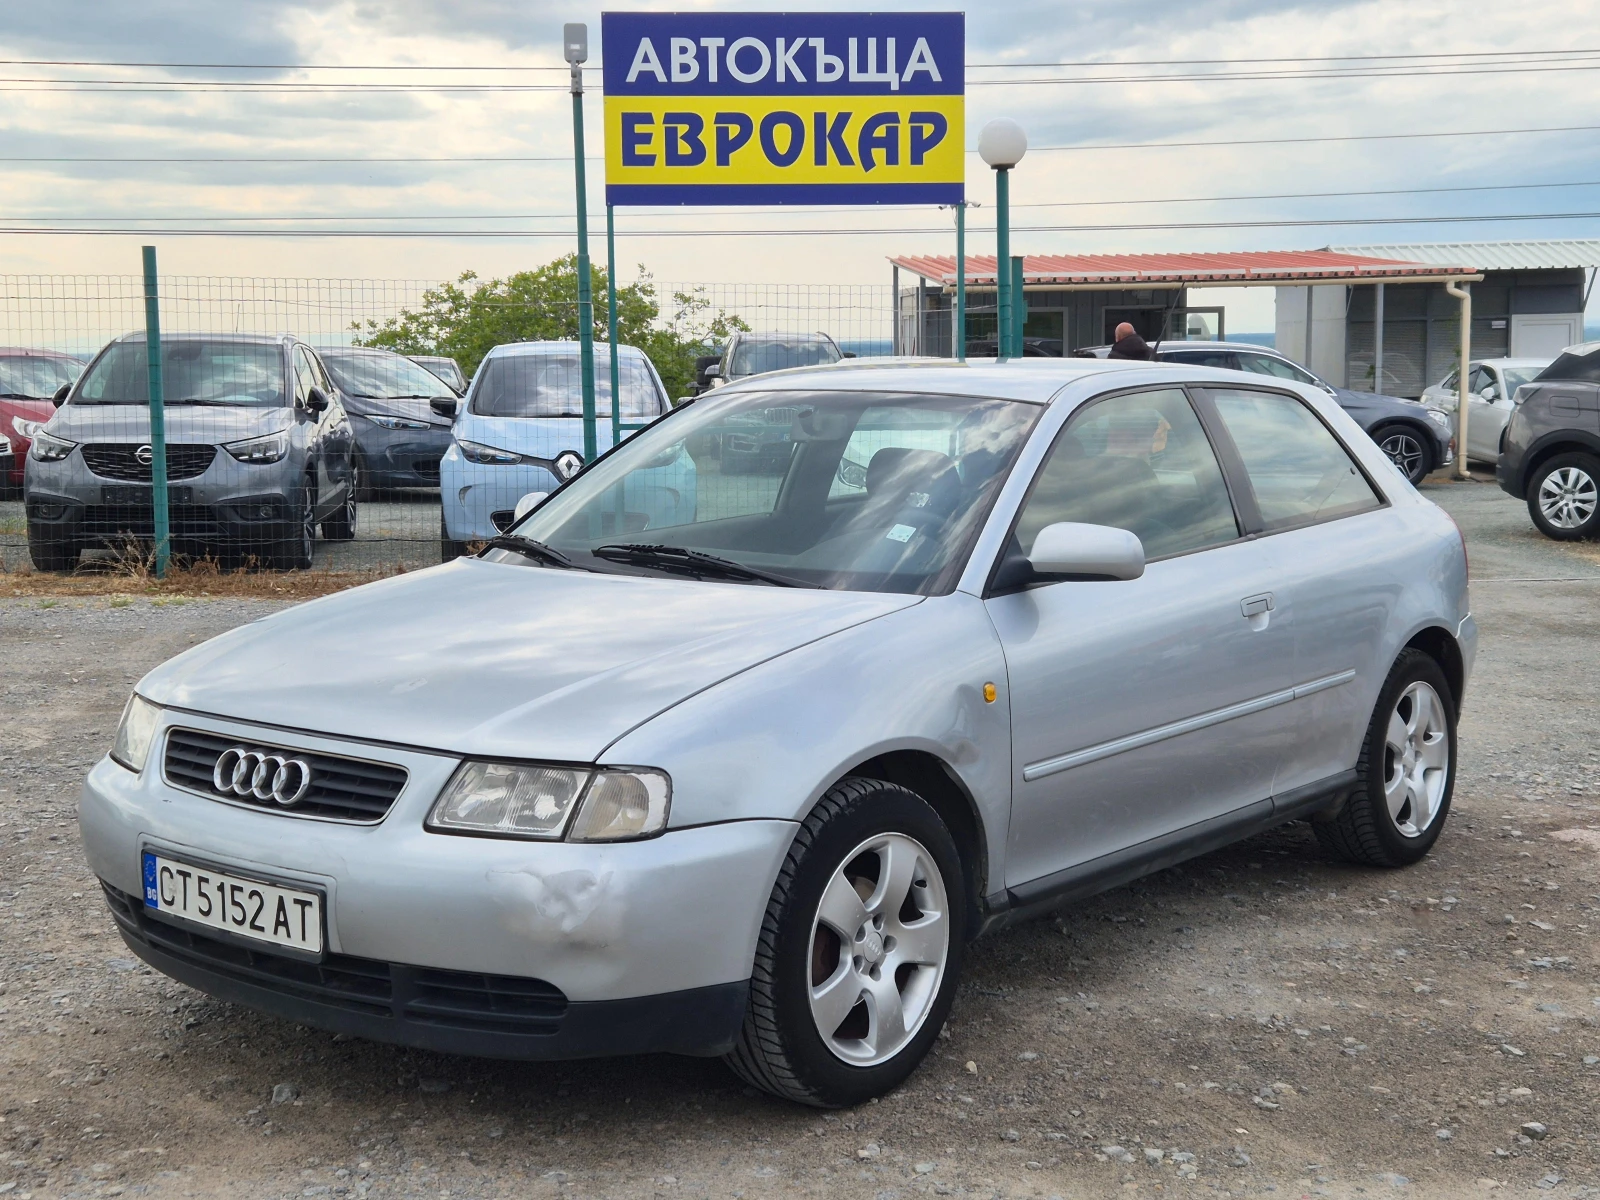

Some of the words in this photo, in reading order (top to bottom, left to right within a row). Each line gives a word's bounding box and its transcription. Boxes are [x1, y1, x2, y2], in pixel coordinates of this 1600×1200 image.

[625, 36, 943, 91] АВТОКЪЩА
[621, 110, 948, 173] ЕВРОКАР
[147, 887, 158, 901] BG
